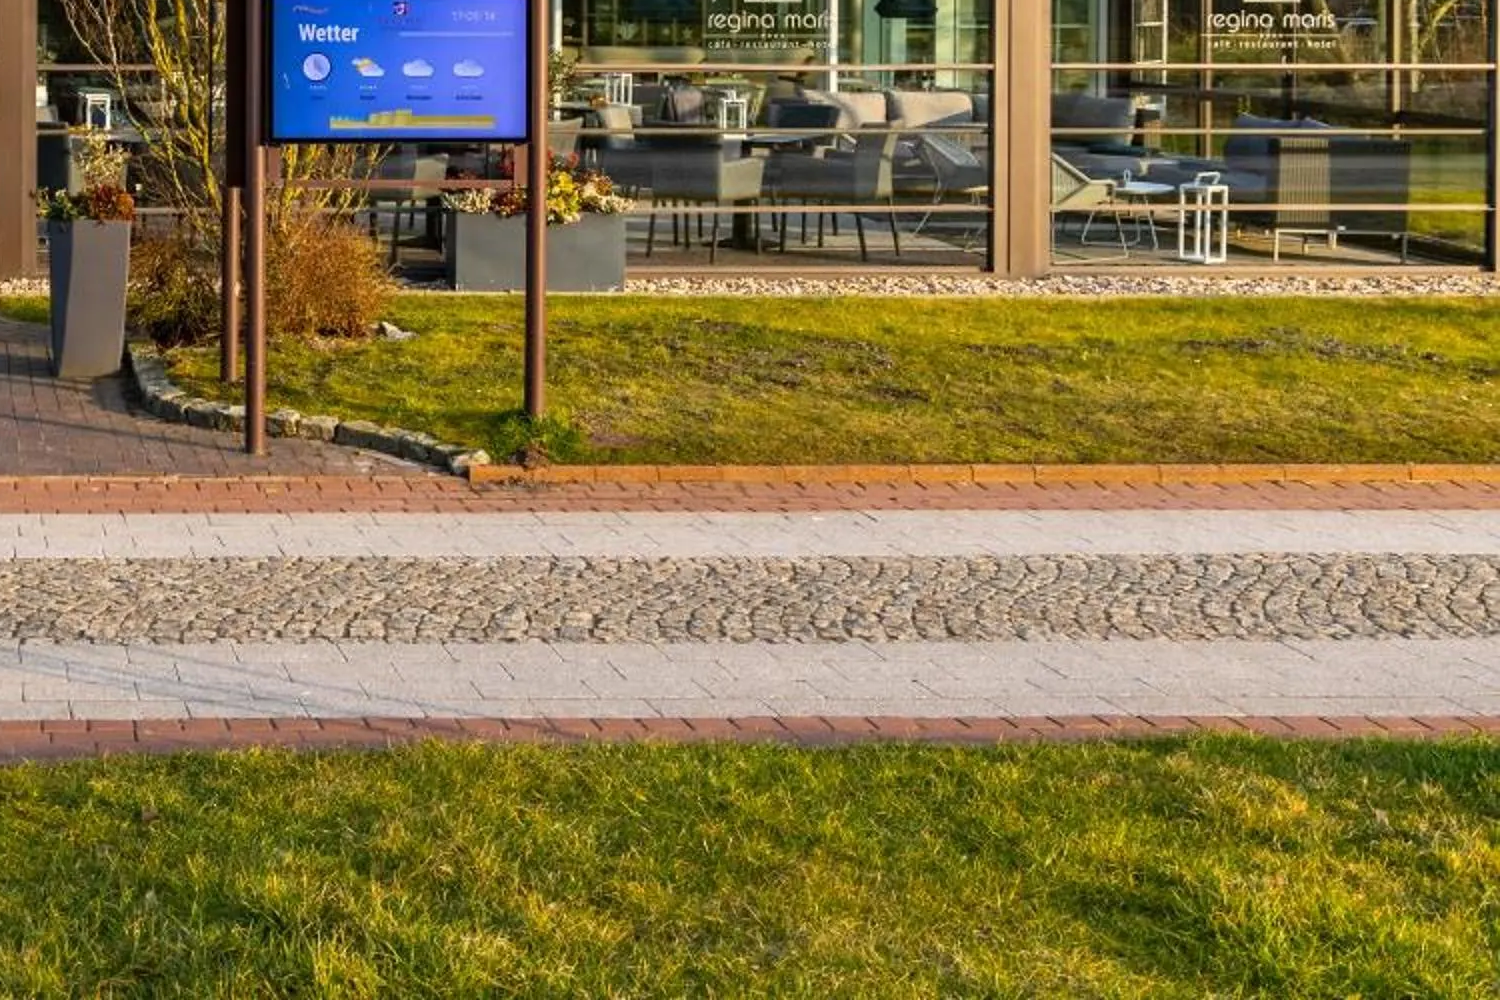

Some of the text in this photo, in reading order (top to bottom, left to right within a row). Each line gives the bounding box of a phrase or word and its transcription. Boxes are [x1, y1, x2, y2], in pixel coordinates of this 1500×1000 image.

[298, 23, 359, 42] Wetter
[707, 9, 775, 33] regina
[1207, 9, 1336, 33] regina maris
